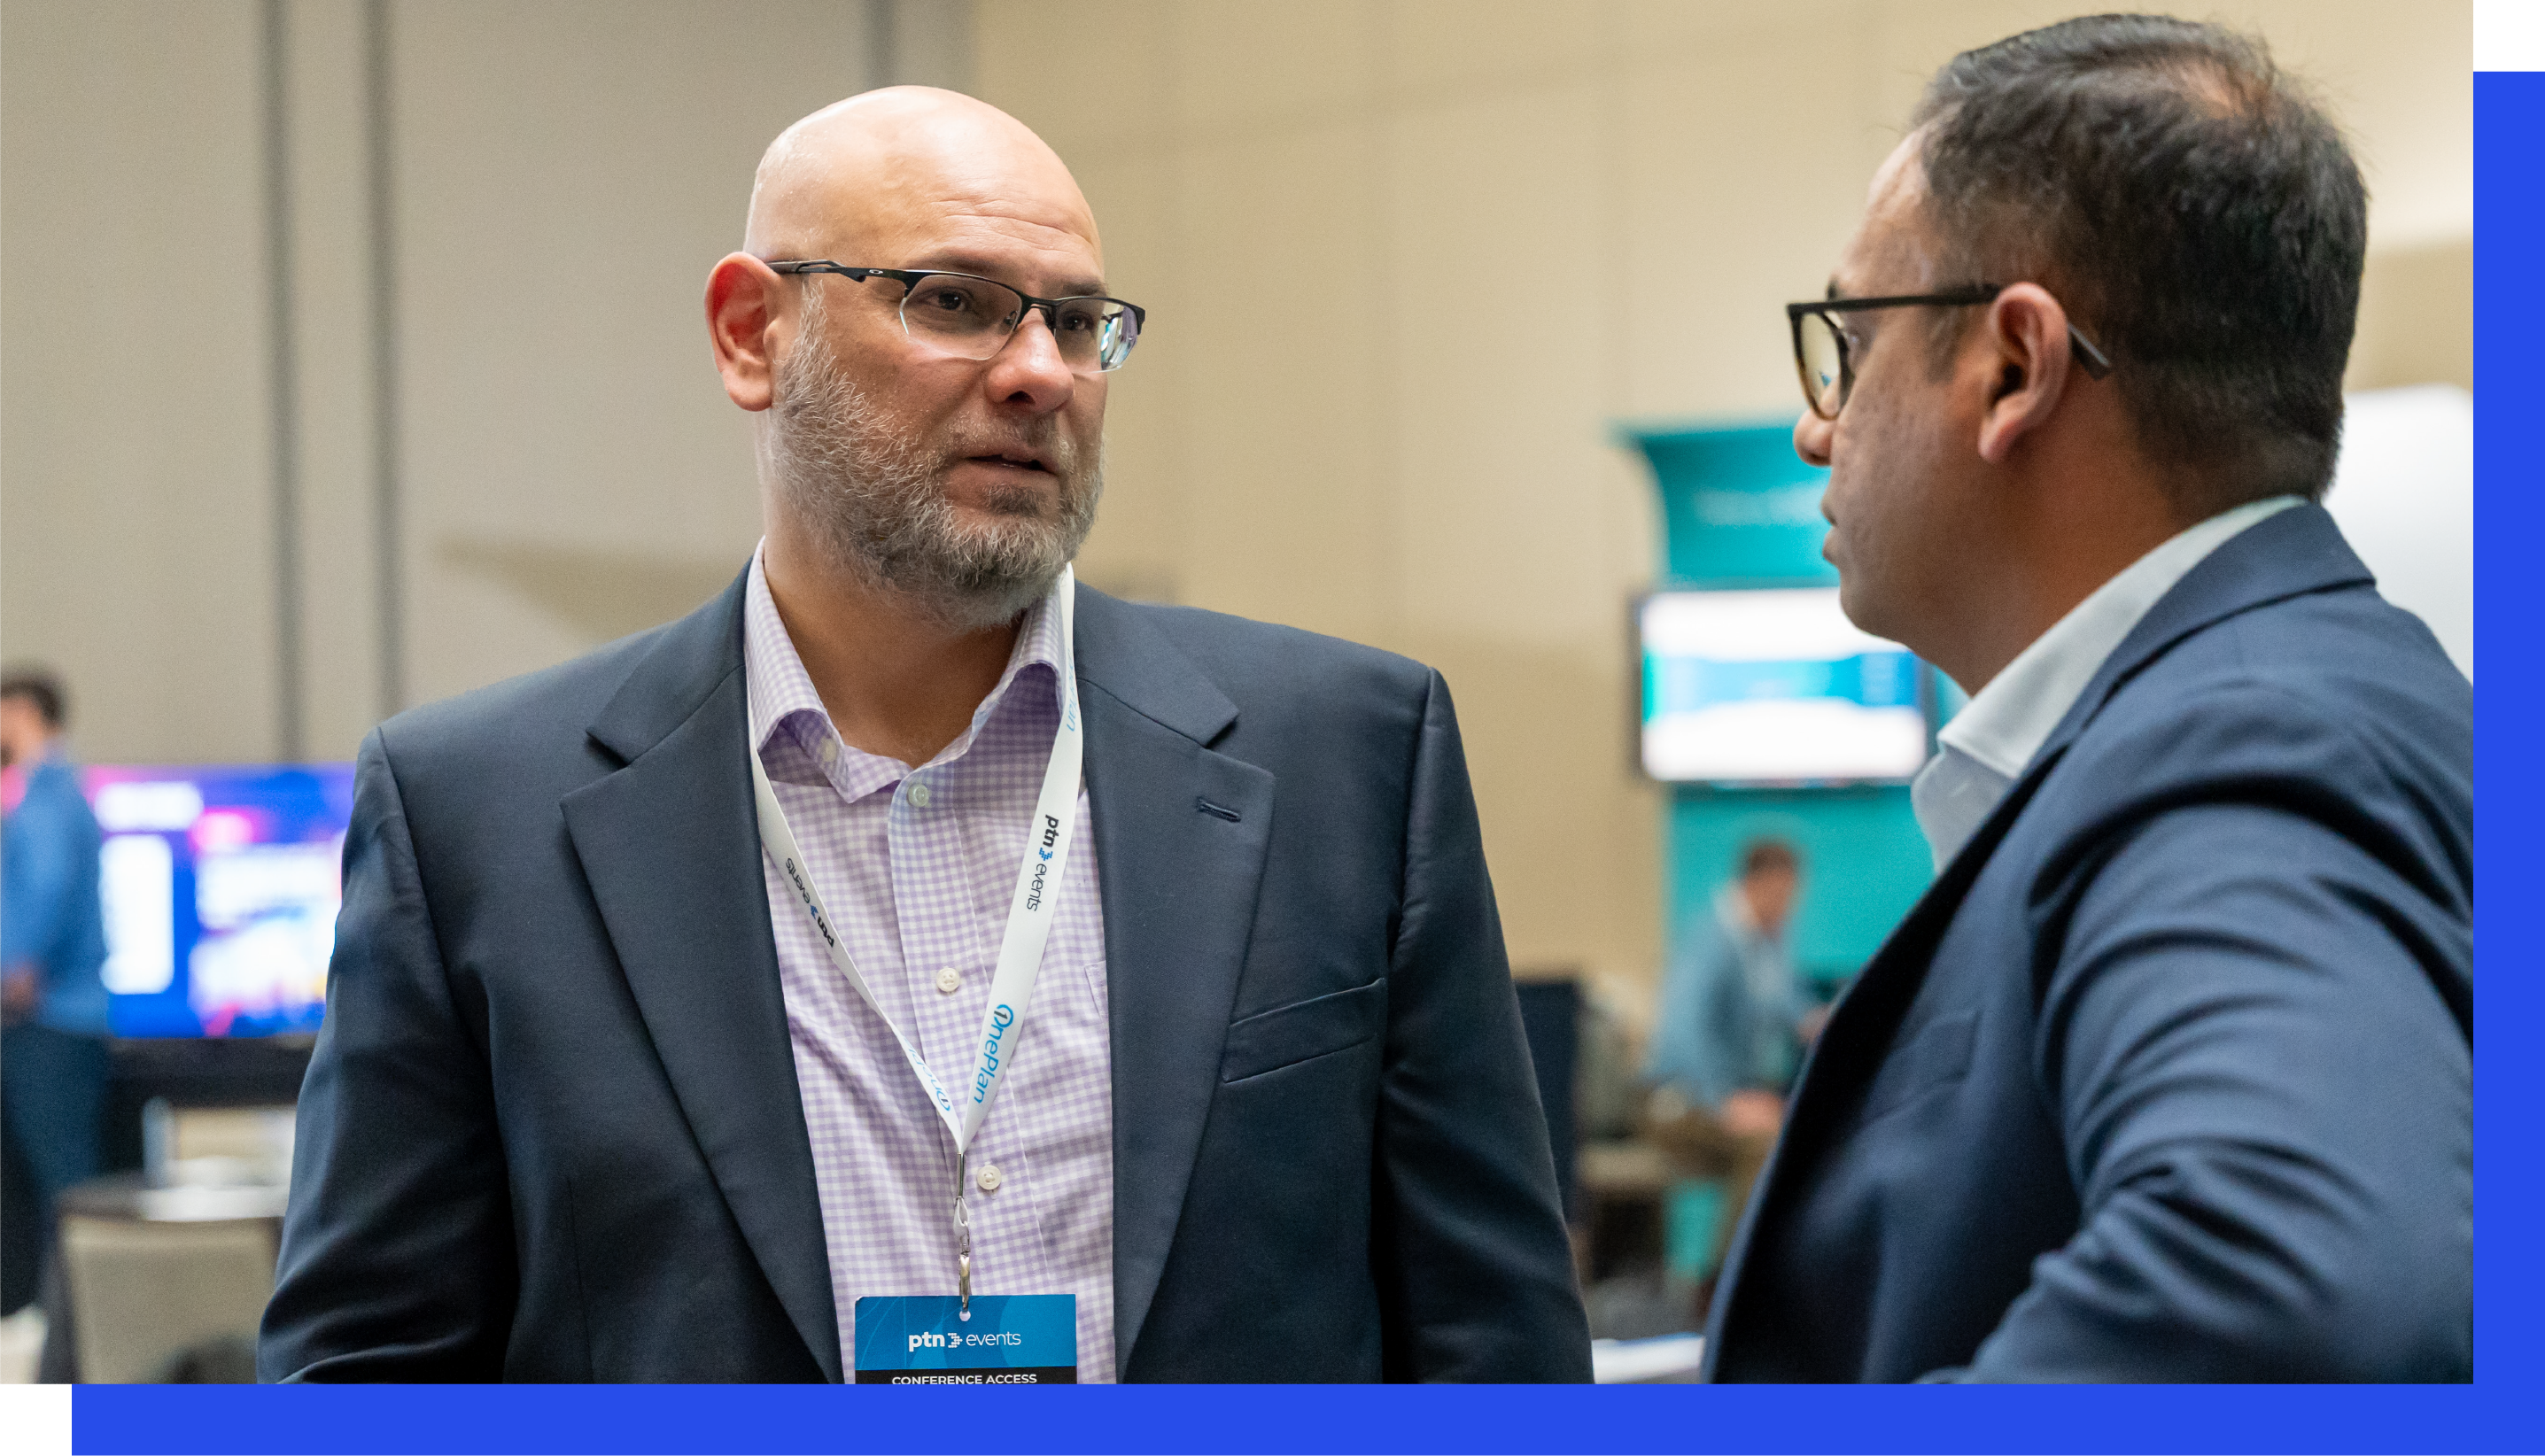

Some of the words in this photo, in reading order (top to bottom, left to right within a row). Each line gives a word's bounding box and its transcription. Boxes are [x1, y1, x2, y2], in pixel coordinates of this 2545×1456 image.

[1043, 814, 1059, 848] ptn
[785, 857, 811, 904] events
[1027, 863, 1047, 911] events
[817, 916, 834, 948] ptn
[974, 1003, 1014, 1104] OnePlan
[904, 1037, 950, 1111] OnePl
[909, 1331, 945, 1352] ptn
[966, 1331, 1021, 1346] events
[892, 1375, 983, 1384] CONFERENCE
[985, 1374, 1037, 1384] ACCESS
